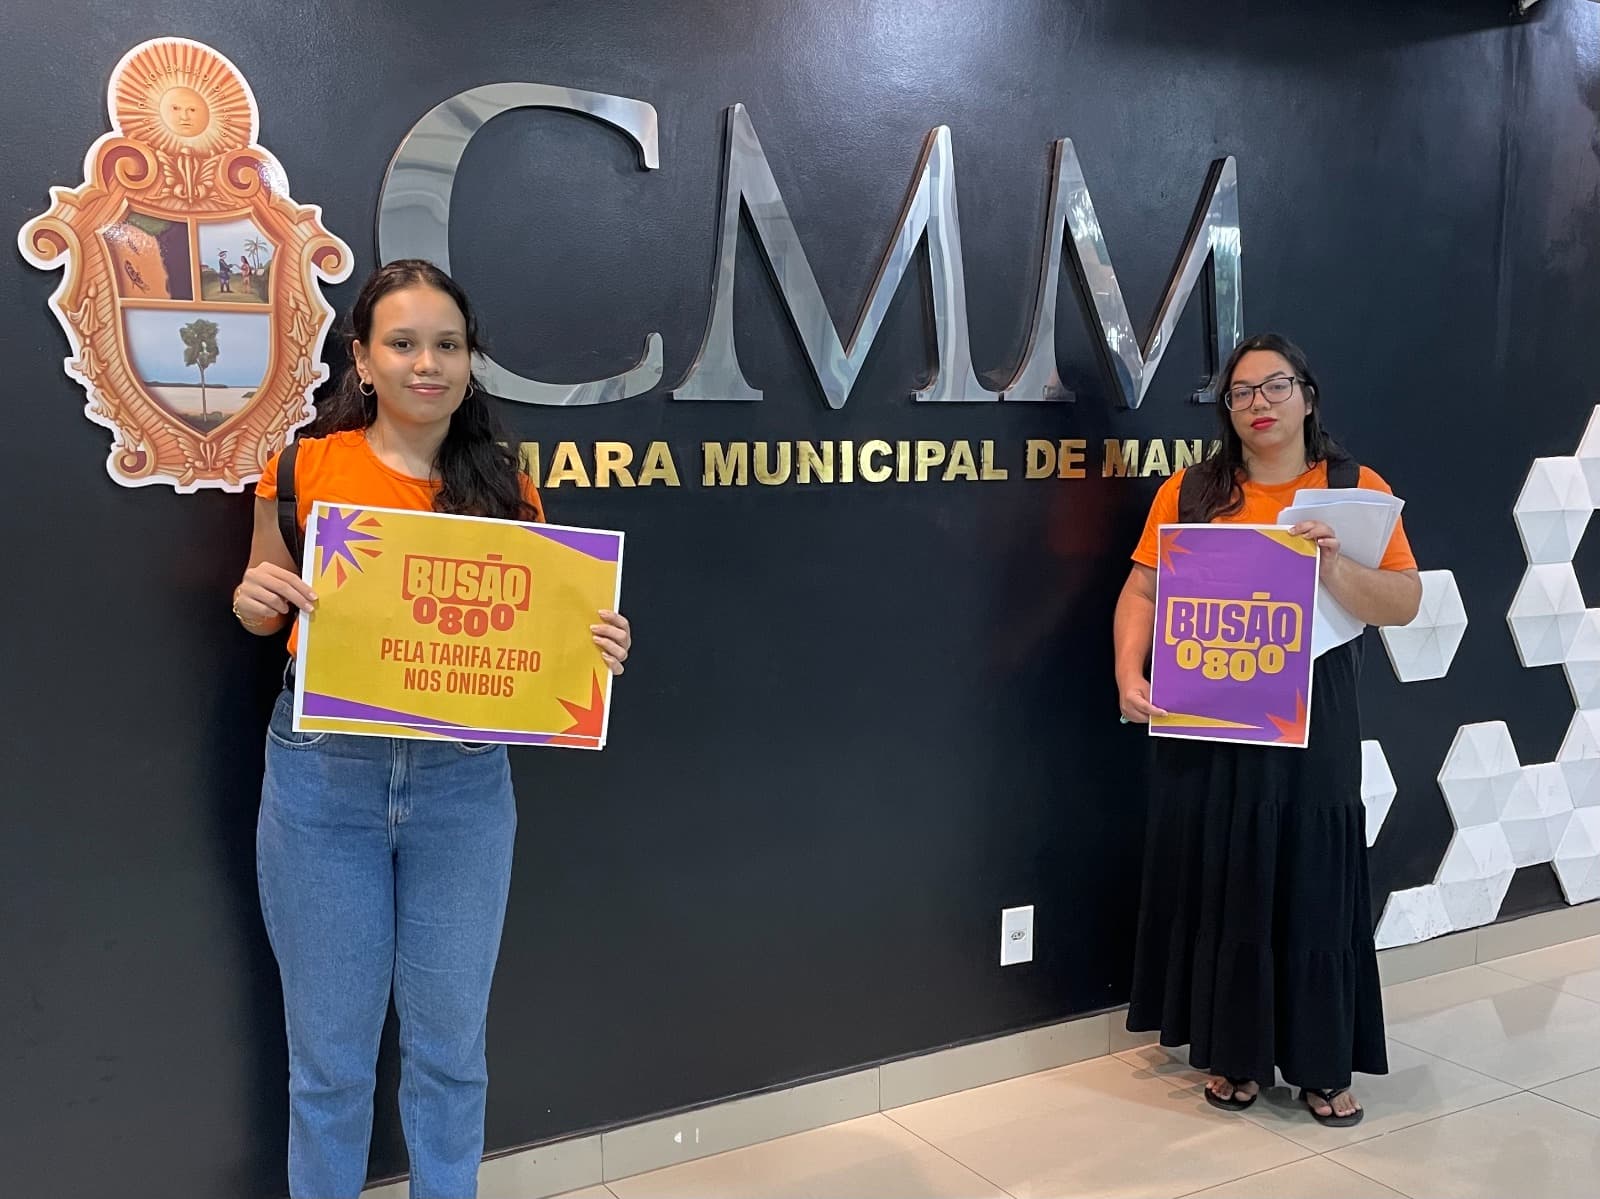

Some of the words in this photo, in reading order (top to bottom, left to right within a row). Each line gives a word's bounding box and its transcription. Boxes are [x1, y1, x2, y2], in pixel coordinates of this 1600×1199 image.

[376, 82, 1246, 410] CMM
[496, 441, 681, 488] MARA
[701, 439, 1008, 487] MUNICIPAL
[1025, 439, 1087, 479] DE
[1101, 438, 1223, 478] MAN
[406, 553, 528, 606] BUSÃO
[412, 596, 515, 637] 0800
[1170, 592, 1298, 646] BUSÃO
[380, 638, 424, 664] PELA
[429, 641, 492, 669] TARIFA
[495, 647, 541, 673] ZERO
[1176, 639, 1286, 682] 0800
[403, 667, 442, 693] NOS
[446, 670, 515, 698] ÔNIBUS
